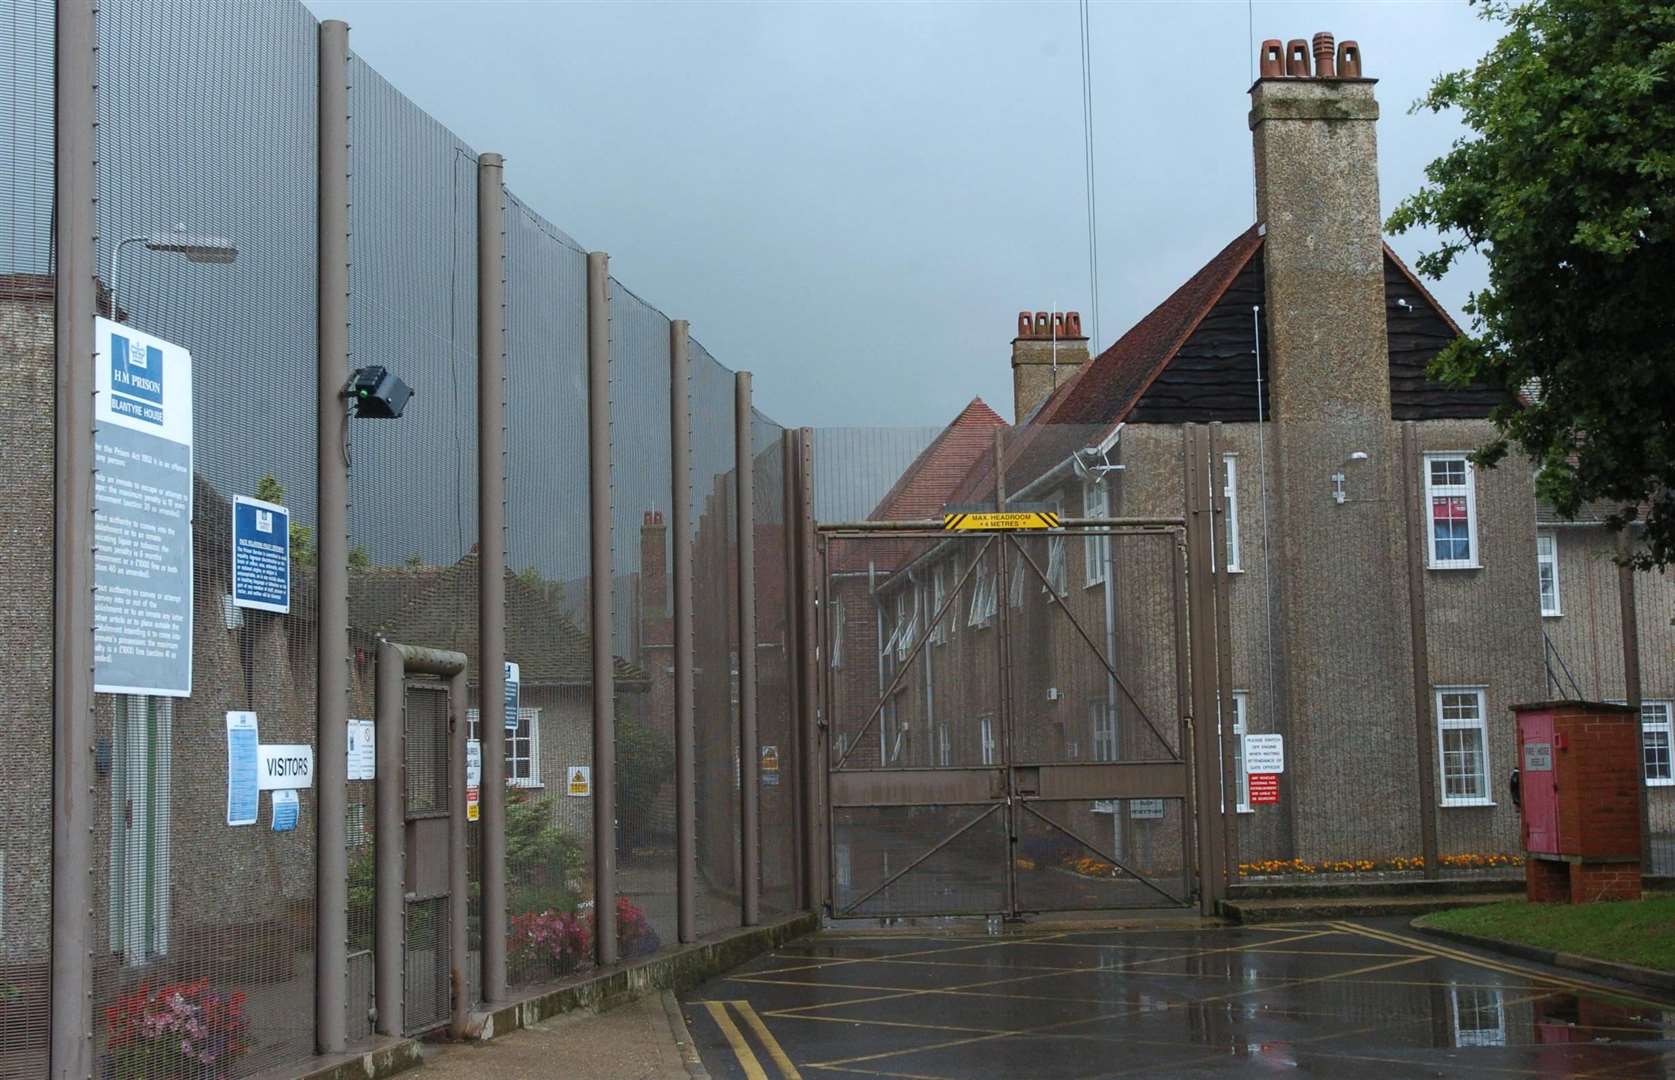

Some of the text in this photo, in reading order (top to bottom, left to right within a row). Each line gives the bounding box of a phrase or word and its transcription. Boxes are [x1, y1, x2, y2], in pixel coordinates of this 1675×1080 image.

[131, 374, 161, 393] PRISON
[111, 398, 163, 422] BLANTYRE HOUSE
[991, 513, 1031, 521] HEADROOM
[266, 757, 308, 776] VISITORS
